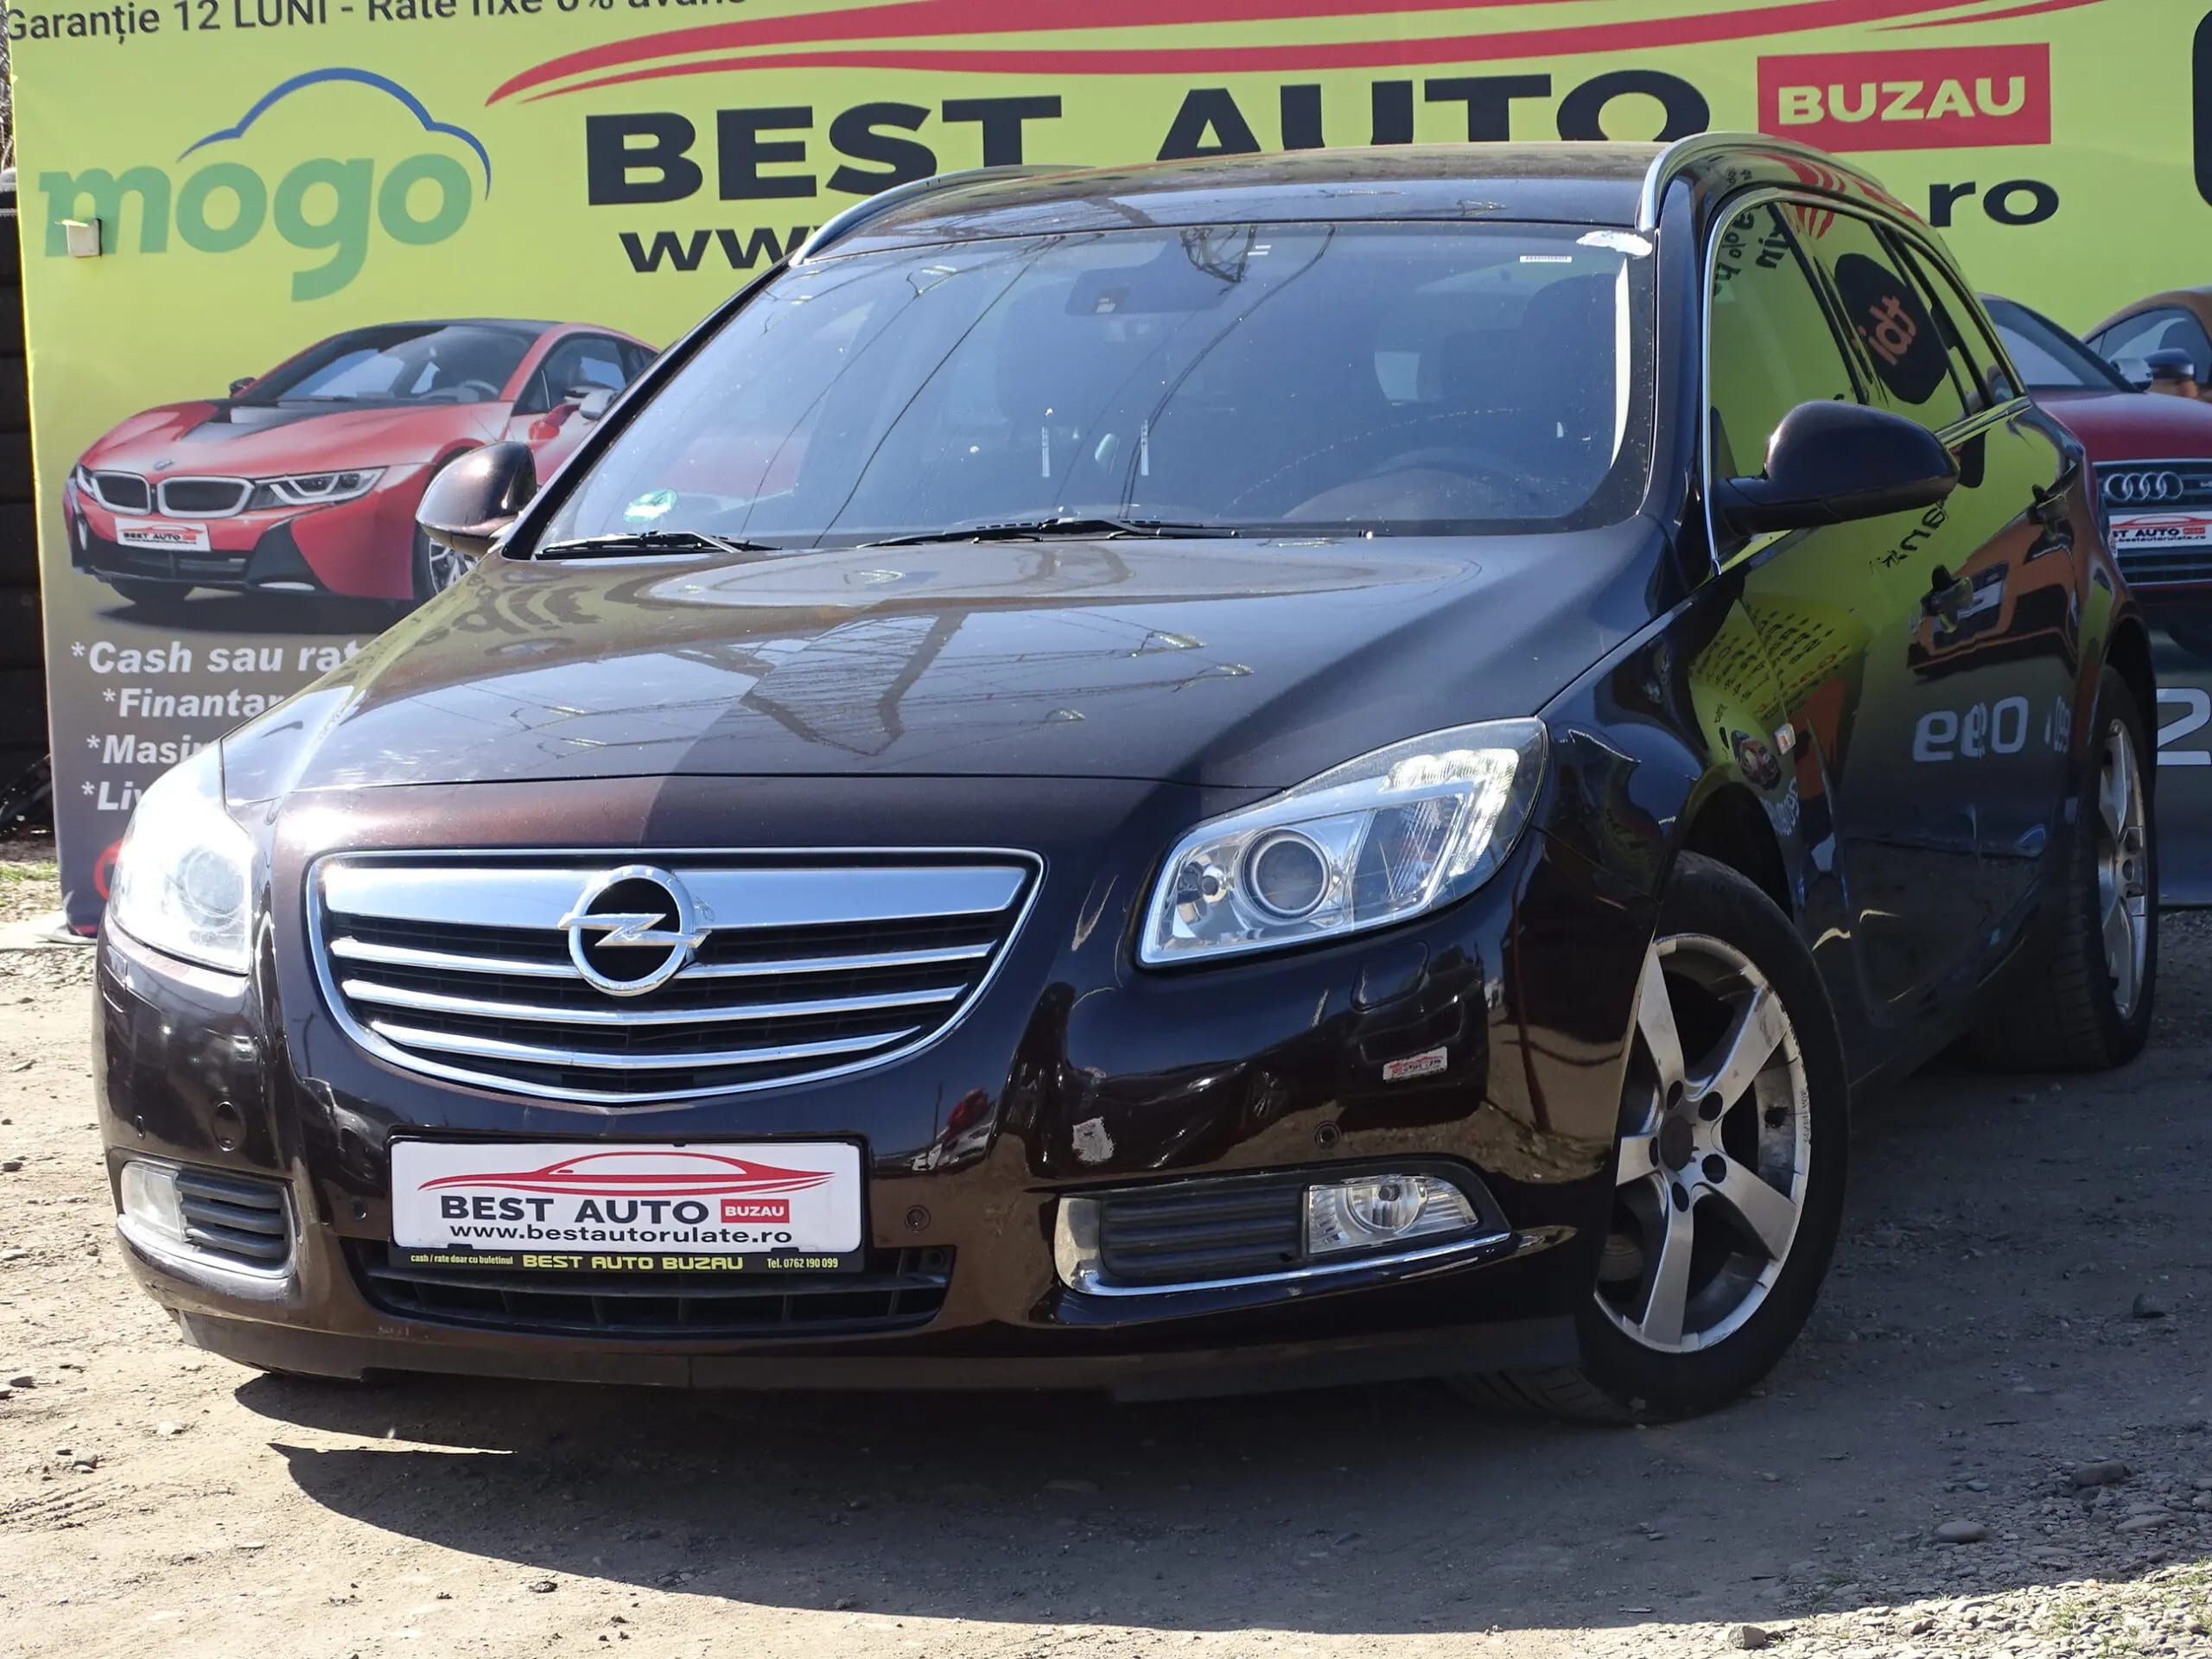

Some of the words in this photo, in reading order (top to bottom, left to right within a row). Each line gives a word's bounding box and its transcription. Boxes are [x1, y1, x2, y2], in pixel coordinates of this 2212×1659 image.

[175, 0, 220, 31] 12
[234, 0, 327, 29] LUNI
[368, 0, 457, 22] Rate
[1778, 75, 2026, 125] BUZAU
[585, 93, 1062, 207] BEST
[1156, 69, 1710, 161] AUTO
[38, 153, 473, 302] mogo
[619, 226, 810, 273] ww
[1929, 179, 2059, 228] ro
[207, 647, 283, 672] sau
[2156, 687, 2212, 766] 2
[442, 1196, 554, 1222] BEST
[574, 1199, 709, 1224] AUTO
[725, 1206, 785, 1217] BUZAU
[450, 1222, 793, 1243] www.bestautorulate.ro
[410, 1255, 429, 1263] cash
[450, 1255, 467, 1264] doar
[479, 1255, 514, 1265] buletinul
[522, 1255, 583, 1268] BEST
[591, 1256, 654, 1270] AUTO
[662, 1256, 744, 1270] BUZAU
[767, 1258, 782, 1268] Tel.
[784, 1258, 804, 1269] 0762
[805, 1258, 822, 1269] 190
[822, 1258, 838, 1269] 099
